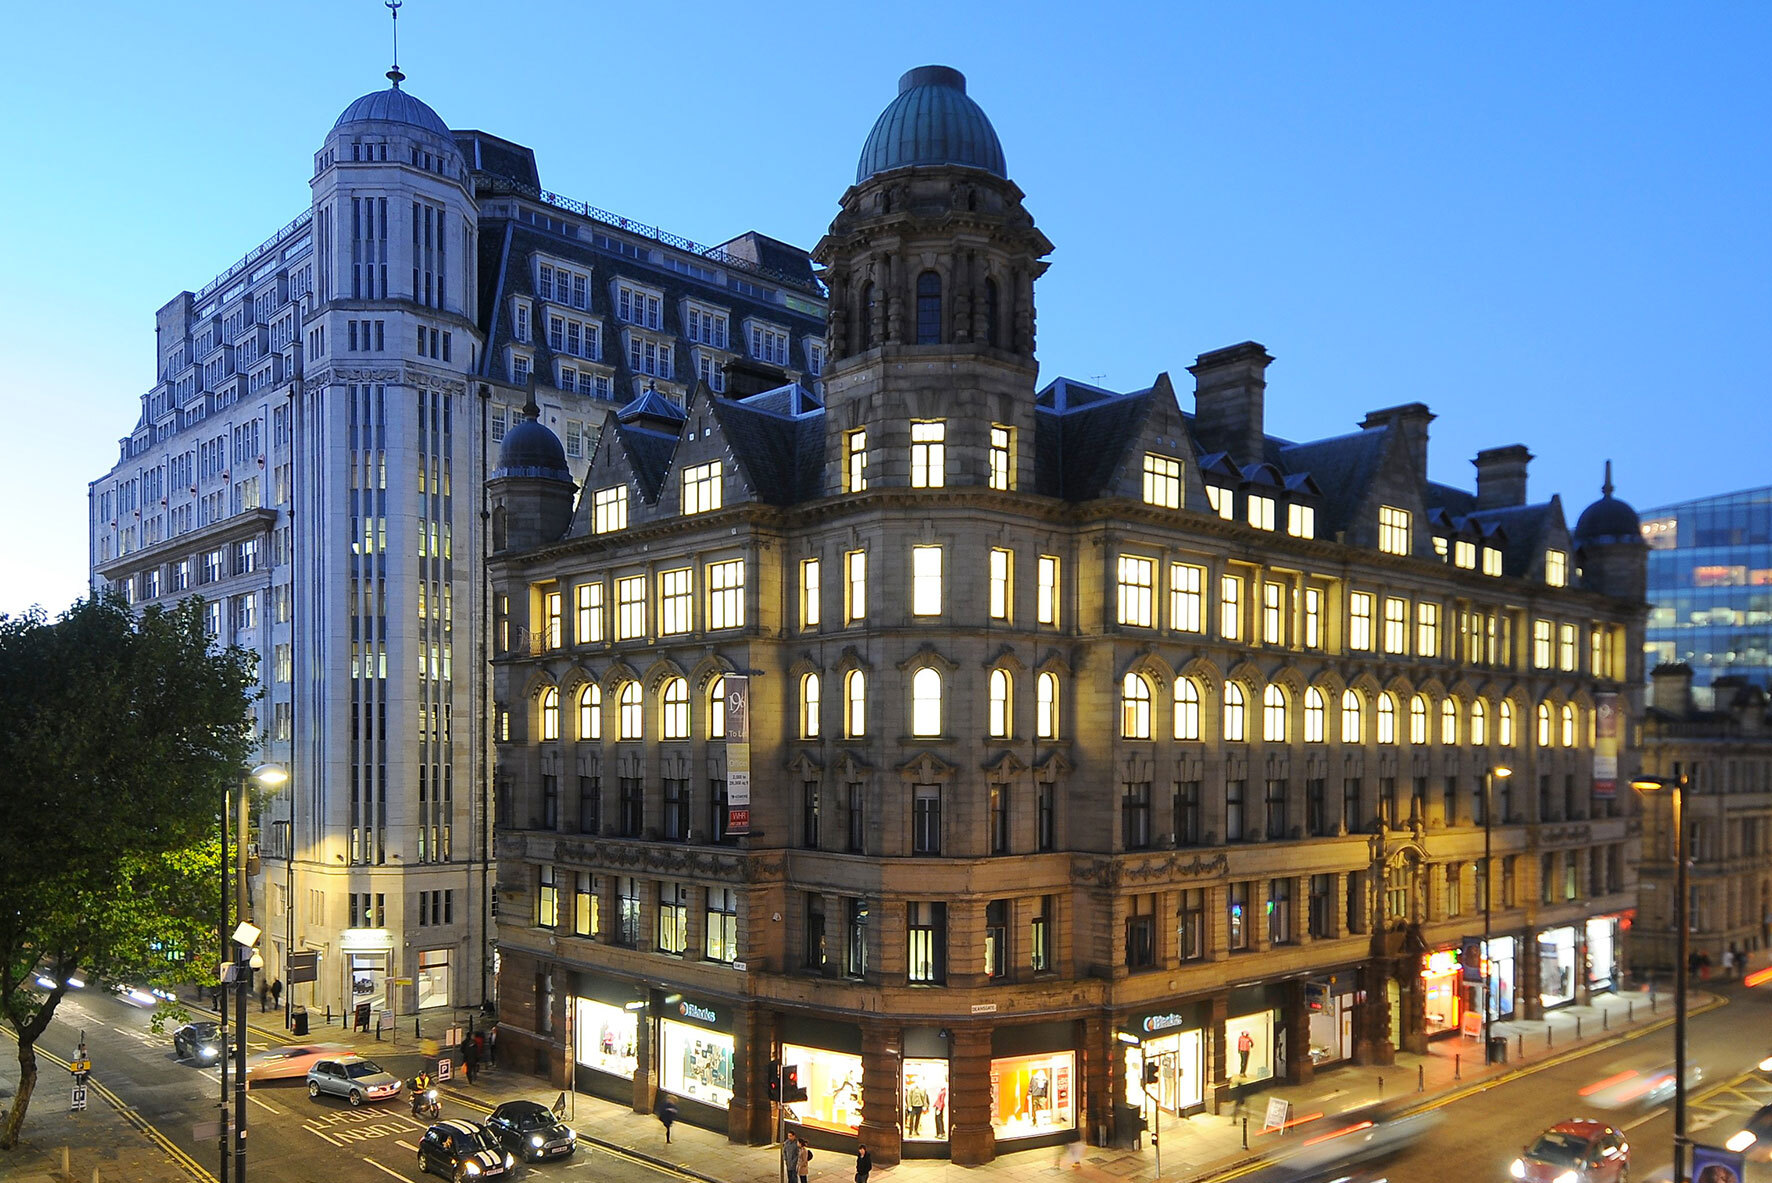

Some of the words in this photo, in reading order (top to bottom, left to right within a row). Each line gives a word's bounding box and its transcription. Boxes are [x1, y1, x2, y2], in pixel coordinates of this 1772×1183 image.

[729, 730, 737, 738] To
[306, 1107, 389, 1130] RIGHT
[333, 1122, 418, 1143] TURN
